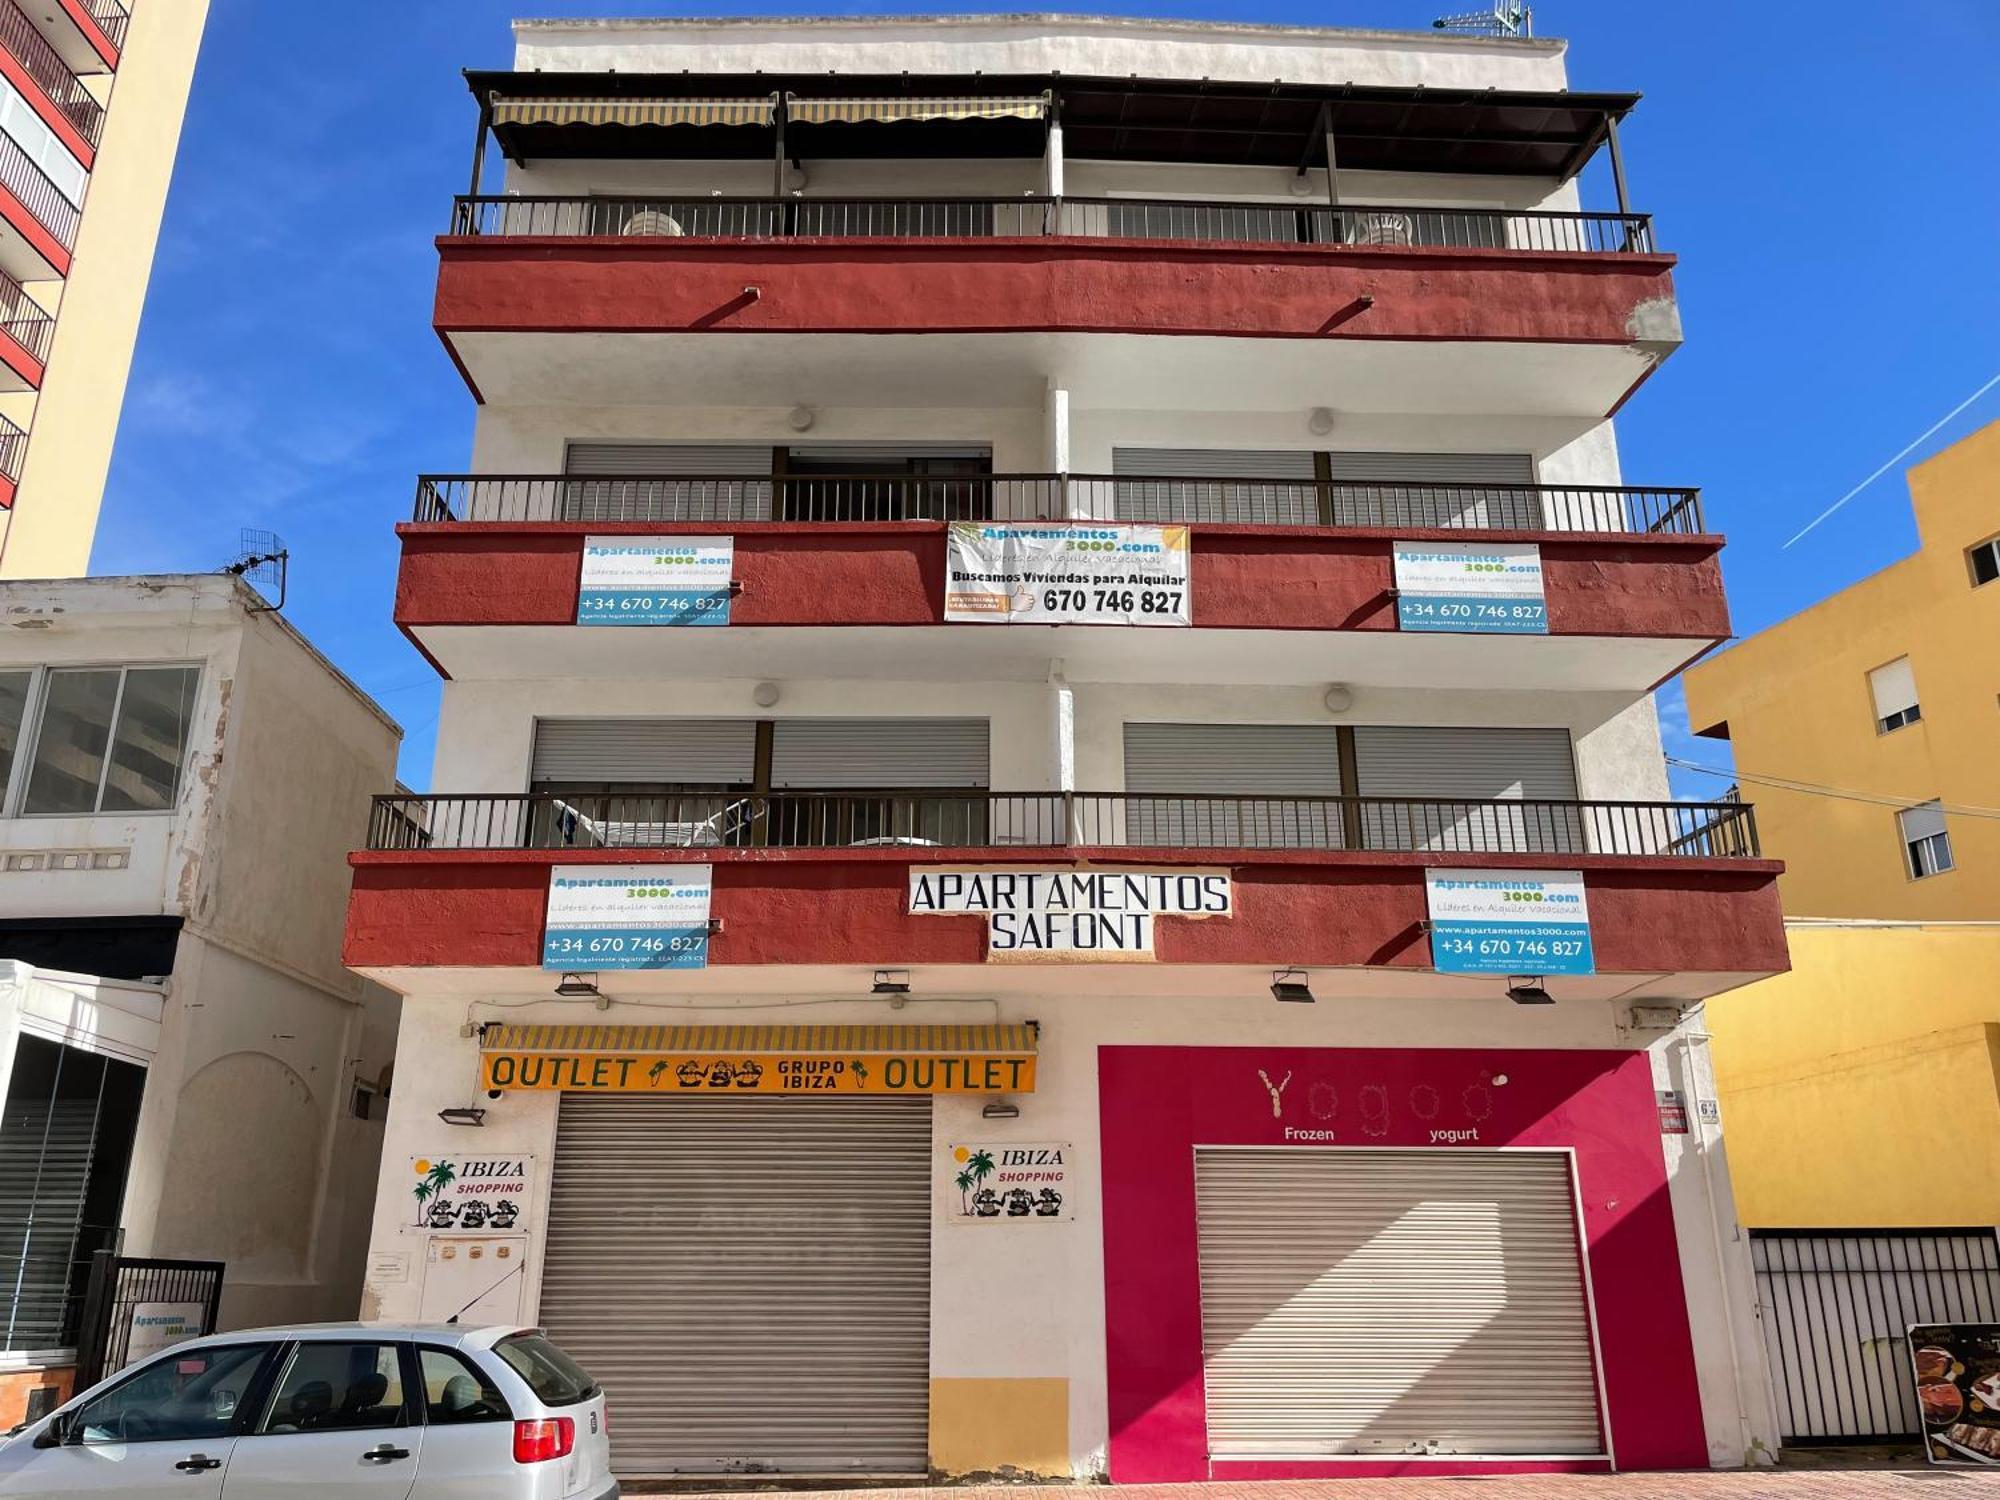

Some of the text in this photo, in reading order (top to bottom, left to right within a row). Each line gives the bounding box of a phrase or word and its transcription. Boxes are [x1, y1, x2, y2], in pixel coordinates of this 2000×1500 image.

[982, 528, 1119, 541] Apartamentos
[587, 547, 698, 556] Apartamentos
[1066, 541, 1160, 553] 3000.com
[655, 556, 731, 565] 3000.com
[1398, 551, 1505, 563] Apartamentos
[1465, 563, 1540, 573] 3000.com
[952, 571, 1186, 587] Buscamos Viviendas para Alquilar
[582, 598, 726, 610] +34 670 746 827
[1044, 590, 1182, 613] 670 746 827
[1402, 604, 1543, 618] +34 670 746 827
[555, 878, 674, 889] Apartamentos
[1435, 879, 1545, 891] Apartamentos
[626, 888, 709, 898] 3000.com
[911, 874, 1229, 911] APARTAMENTOS
[1503, 892, 1579, 903] 3000.com
[991, 913, 1150, 950] SAFONT
[1436, 927, 1586, 936] www.apartamentos3000.com
[549, 937, 705, 951] +34 670 746 827
[1442, 940, 1583, 955] +34 670 746 827
[491, 1056, 637, 1087] OUTLET
[778, 1060, 845, 1074] GRUPO
[884, 1059, 1027, 1089] OUTLET
[783, 1076, 837, 1089] IBIZA
[1284, 1127, 1334, 1140] Frozen
[1430, 1127, 1479, 1143] yogurt
[1000, 1150, 1064, 1166] IBIZA
[460, 1161, 525, 1177] IBIZA
[998, 1172, 1064, 1182] SHOPPING
[456, 1183, 524, 1194] SHOPPING
